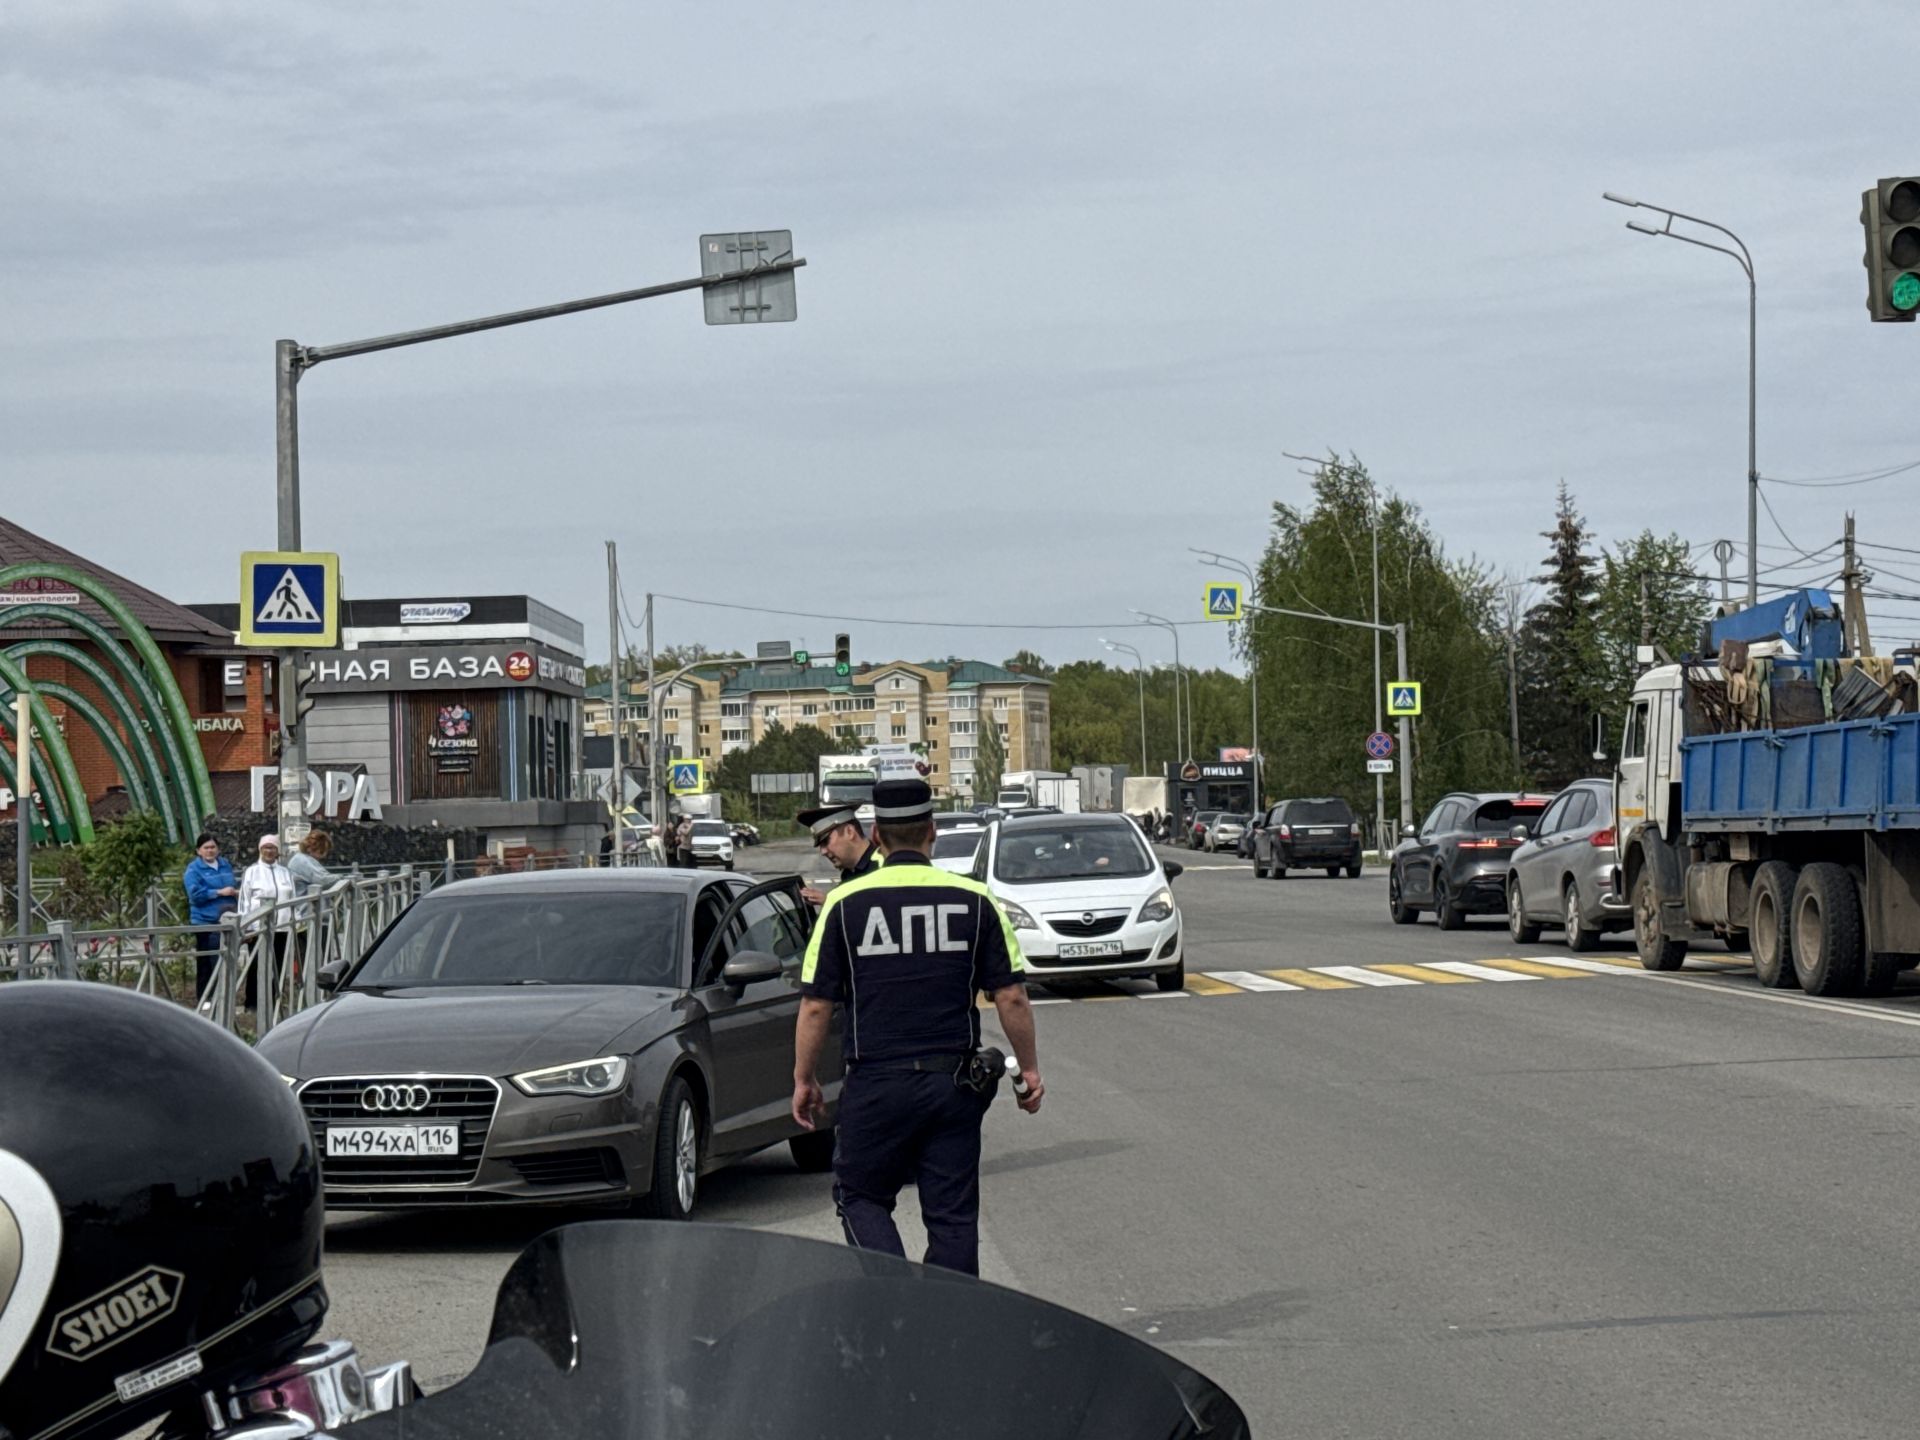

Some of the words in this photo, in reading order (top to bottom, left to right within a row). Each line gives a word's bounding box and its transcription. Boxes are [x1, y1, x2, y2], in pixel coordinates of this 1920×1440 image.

[409, 655, 505, 680] БАЗА
[509, 656, 531, 670] 24
[428, 734, 437, 748] 4
[437, 738, 478, 748] сезона
[1203, 766, 1243, 776] ПИЦЦА
[857, 904, 968, 956] ДПС
[333, 1130, 416, 1153] М494ХА
[420, 1129, 453, 1146] 116
[61, 1274, 171, 1353] SHOEI
